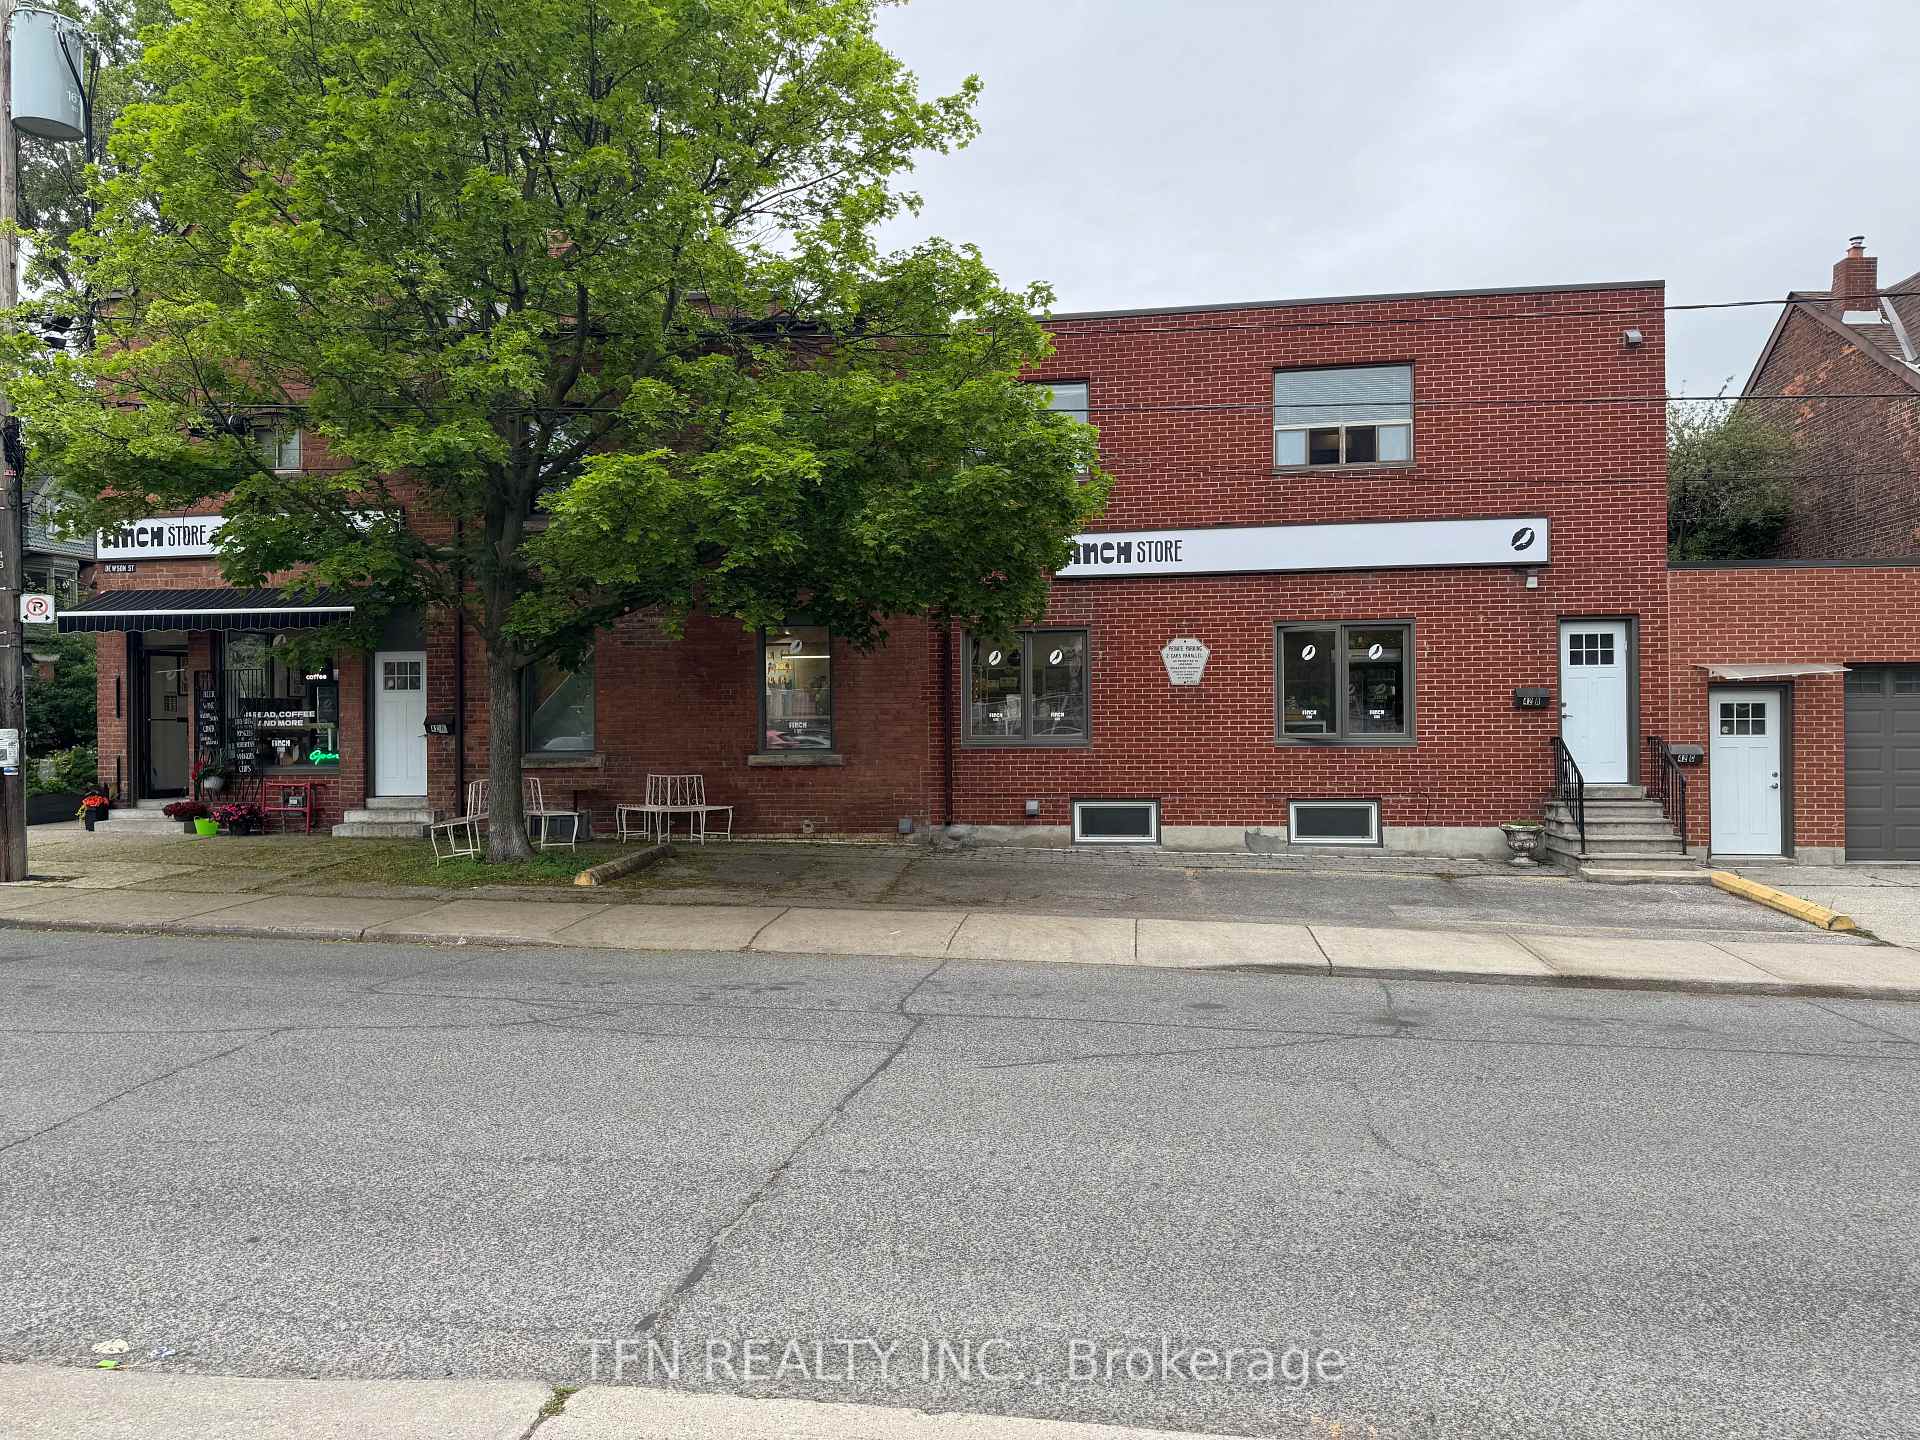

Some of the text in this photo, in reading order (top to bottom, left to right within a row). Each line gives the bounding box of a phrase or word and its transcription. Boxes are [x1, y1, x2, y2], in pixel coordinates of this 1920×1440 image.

[102, 525, 207, 548] INCH STORE
[1073, 539, 1183, 565] INCH STORE
[305, 673, 328, 681] coffee
[279, 710, 316, 718] COFFEE
[277, 719, 304, 727] MORE
